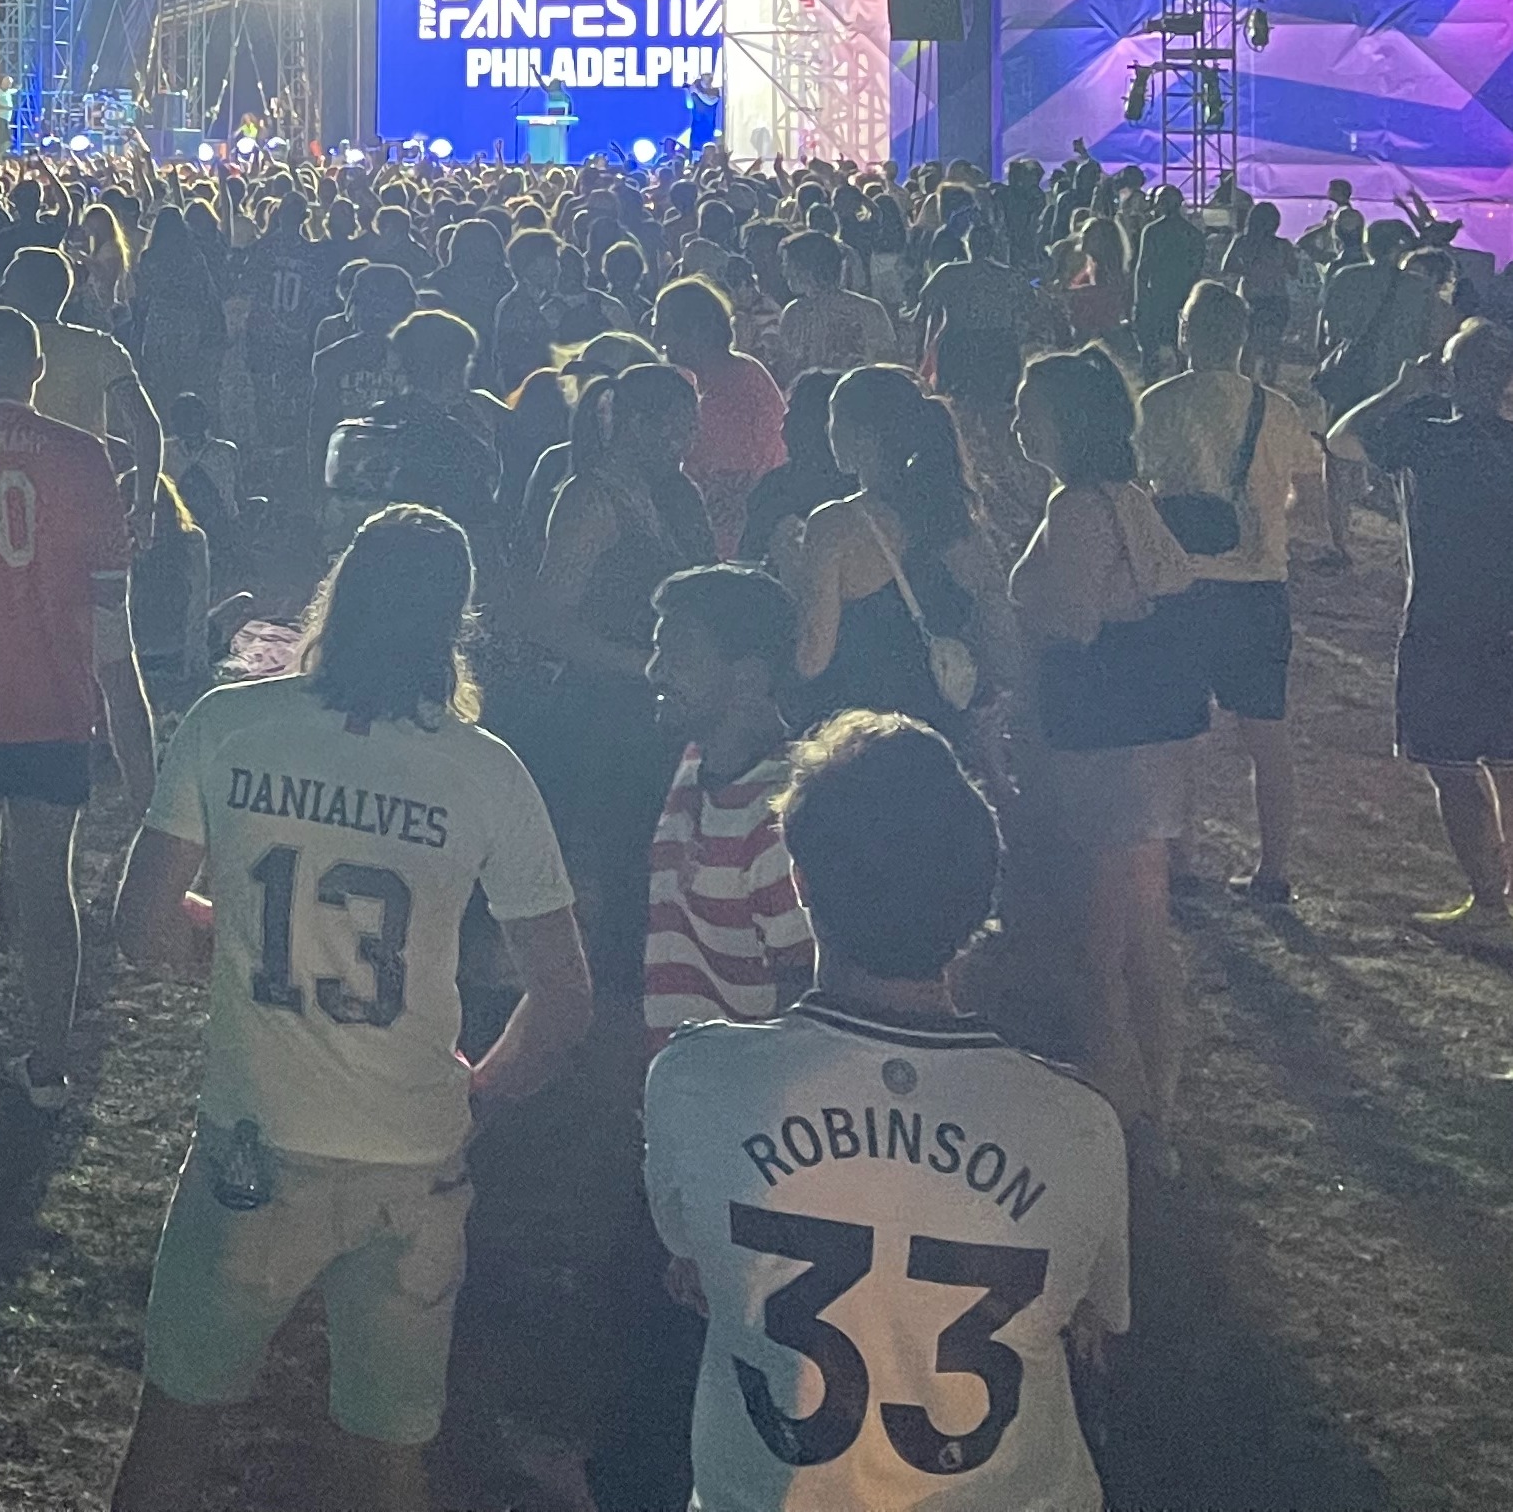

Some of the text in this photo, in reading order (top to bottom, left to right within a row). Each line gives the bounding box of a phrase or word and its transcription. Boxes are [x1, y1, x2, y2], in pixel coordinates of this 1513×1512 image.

[226, 766, 449, 849] DANIALVES
[247, 843, 412, 1030] 13
[741, 1105, 1048, 1223] ROBINSON
[728, 1199, 1051, 1476] 33
